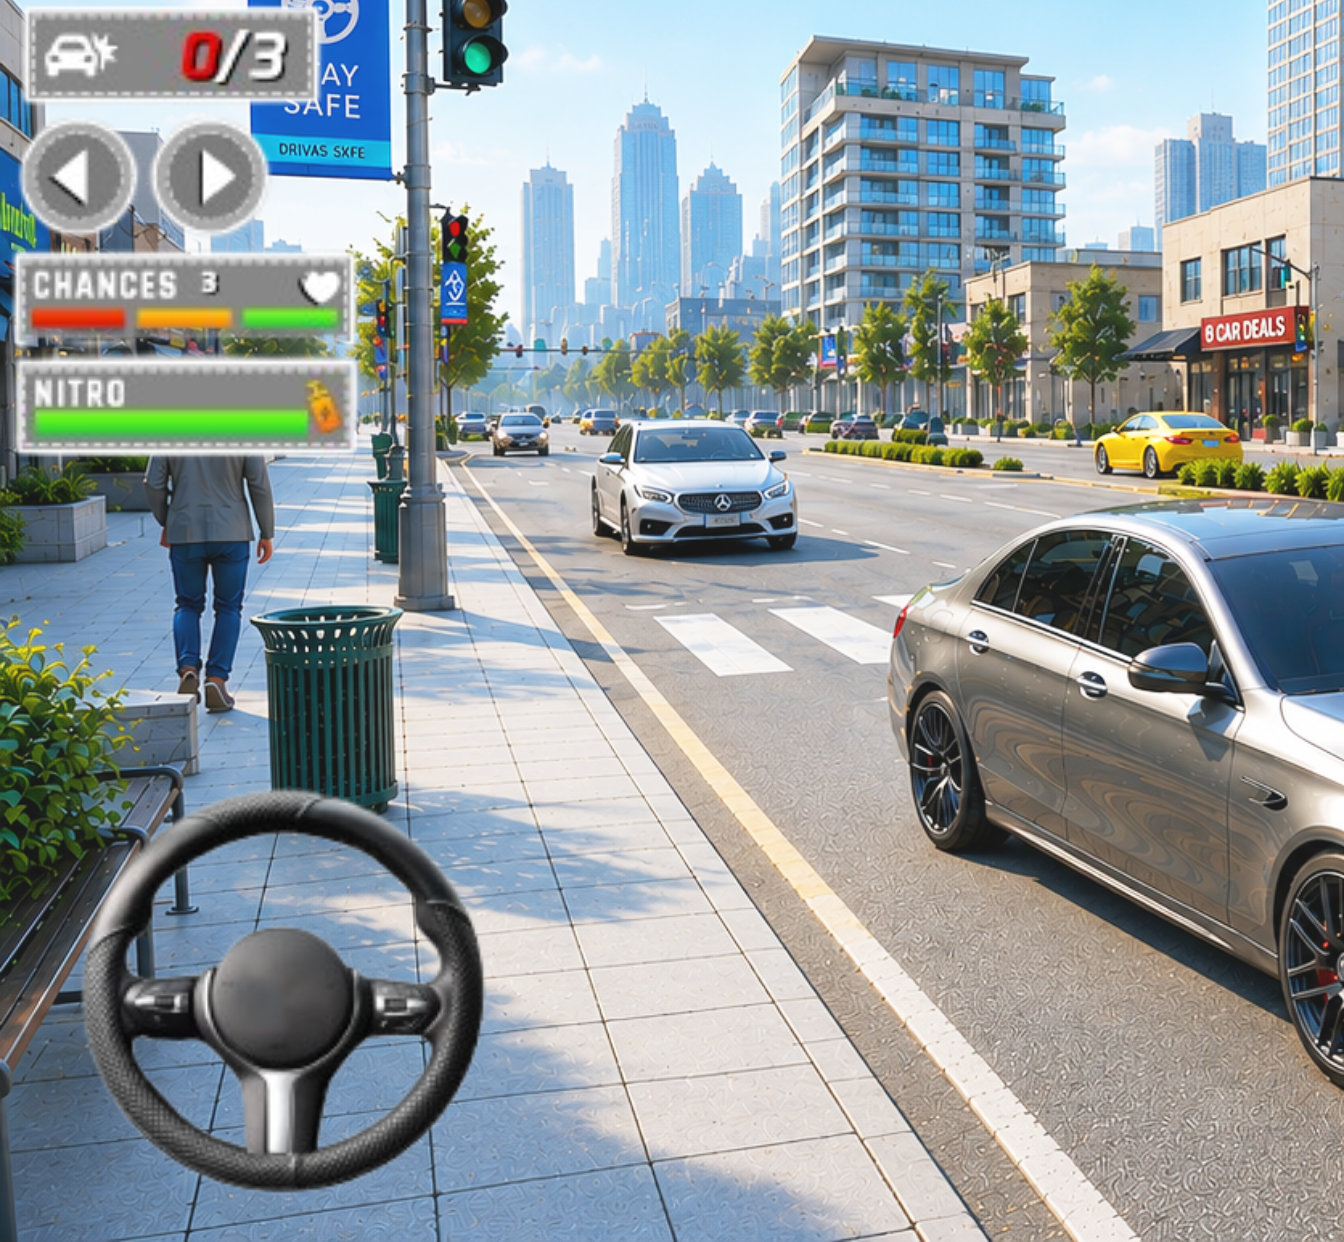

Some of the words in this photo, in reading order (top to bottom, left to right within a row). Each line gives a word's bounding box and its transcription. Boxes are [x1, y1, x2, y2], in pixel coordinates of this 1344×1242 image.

[320, 62, 359, 87] AY
[284, 94, 361, 119] SAFE
[1216, 321, 1240, 342] CAR
[1243, 315, 1285, 340] DEALS
